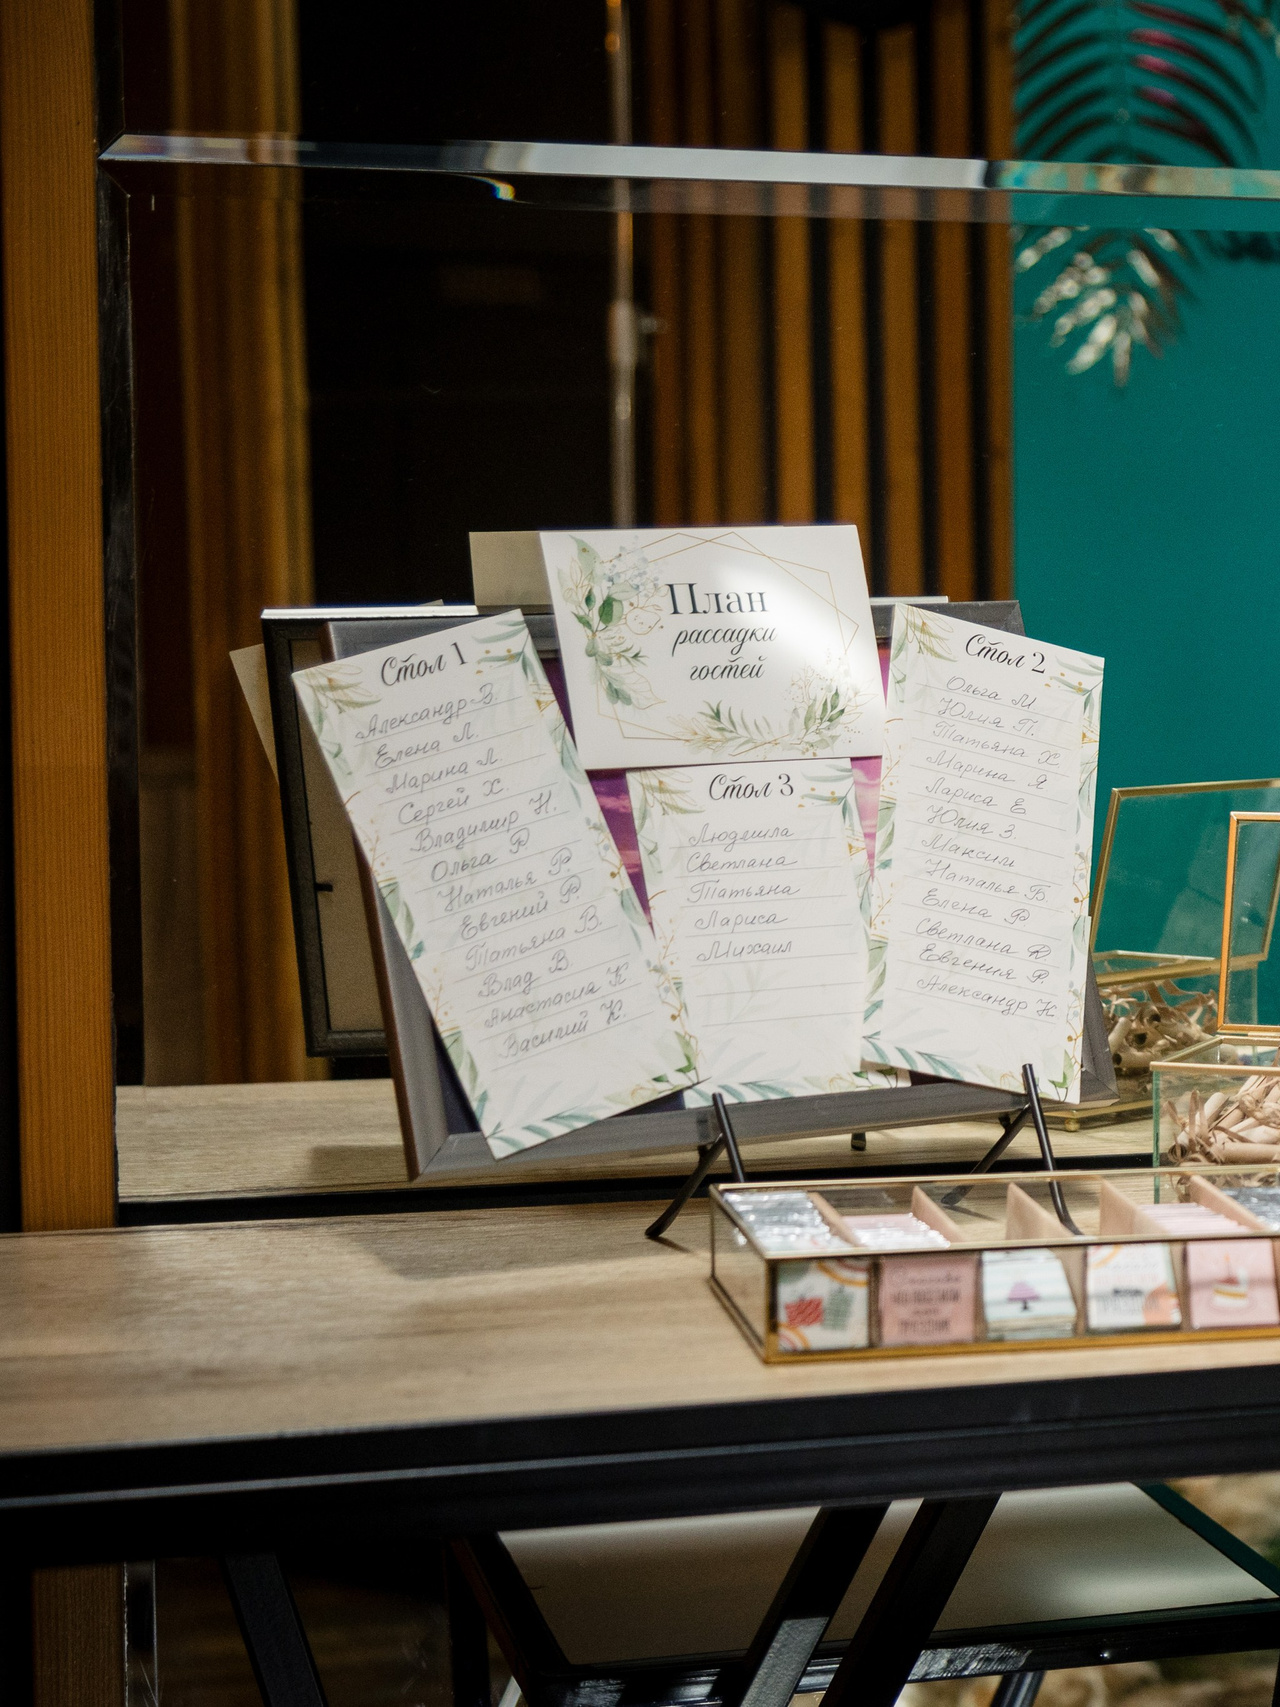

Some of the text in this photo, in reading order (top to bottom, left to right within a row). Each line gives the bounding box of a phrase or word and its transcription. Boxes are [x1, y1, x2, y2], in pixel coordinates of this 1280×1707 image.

[665, 582, 770, 616] План
[671, 625, 778, 658] рассадки
[965, 633, 1046, 674] Стол 2
[381, 641, 469, 687] Стол 1
[690, 655, 767, 682] гостей
[946, 675, 1002, 700] Ольга
[355, 698, 467, 740] Александр
[938, 697, 1005, 728] Юлия
[374, 740, 441, 769] Елена
[933, 720, 1029, 757] Татьяна
[385, 761, 469, 793] Марина
[926, 750, 1016, 782] Марина
[709, 773, 794, 801] Стол 3
[926, 776, 998, 807] Лариса
[398, 787, 470, 825] Сергей
[927, 804, 994, 835] Юлия
[410, 811, 519, 852] Владимир
[689, 822, 795, 852] Людмила
[431, 853, 498, 882] Ольга
[687, 852, 800, 873] Светлана
[921, 834, 1016, 868] Максим
[437, 872, 537, 912] Наталья
[687, 880, 801, 903] Татьяна
[925, 858, 1019, 895] Наталья
[460, 890, 548, 940] Евгений
[922, 888, 993, 918] Елена
[695, 910, 788, 934] Лариса
[916, 918, 1019, 954] Светлана
[465, 926, 566, 971] Татьяна
[697, 940, 793, 963] Михаил
[919, 943, 1017, 980] Евгения
[478, 971, 539, 997] Влад
[917, 974, 1028, 1016] Александр
[484, 981, 602, 1028] Анастасия
[498, 1010, 588, 1058] Василий
